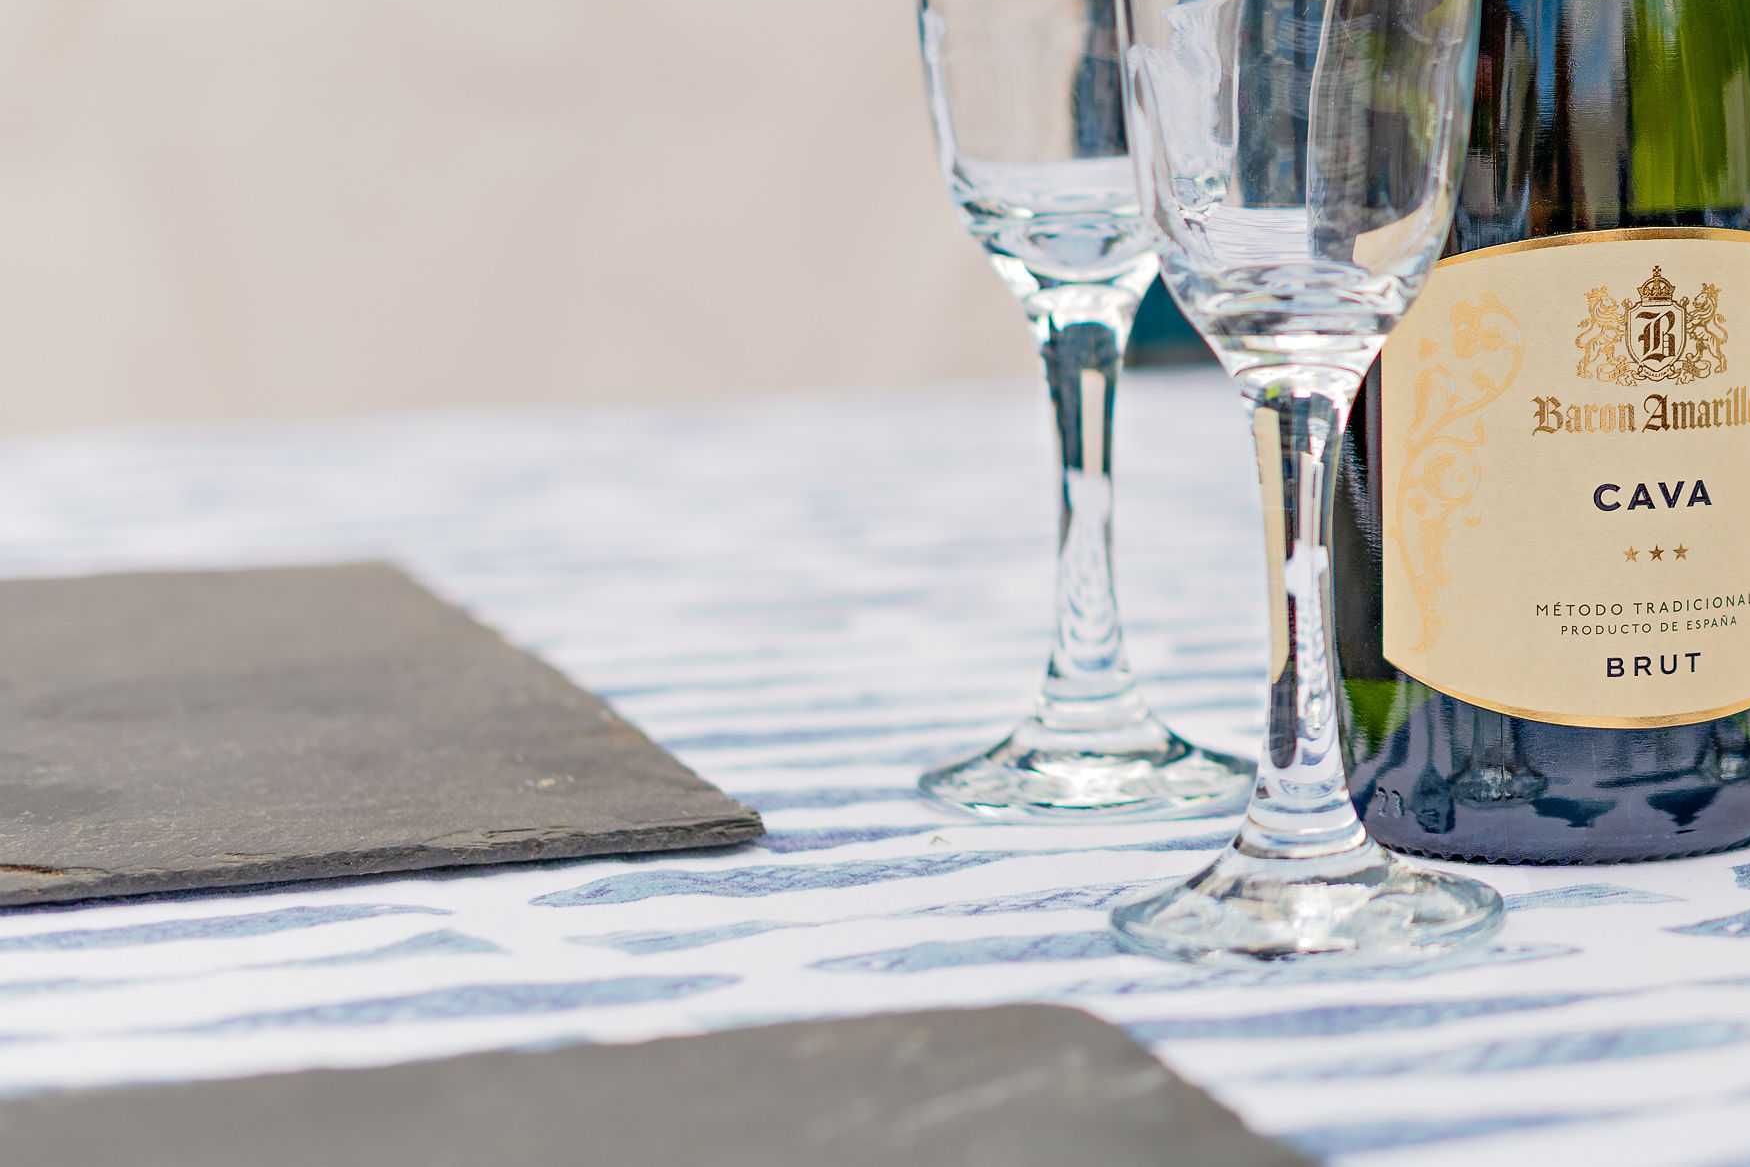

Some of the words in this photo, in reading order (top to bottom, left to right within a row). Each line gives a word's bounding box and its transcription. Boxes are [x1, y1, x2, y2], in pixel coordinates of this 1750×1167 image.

[1635, 310, 1676, 363] B
[1530, 395, 1637, 437] Baron
[1593, 479, 1713, 512] CAVA
[1536, 601, 1624, 617] MÉTODO
[1561, 623, 1652, 636] PRODUCTO
[1660, 621, 1678, 632] DE
[1686, 615, 1737, 631] ESPAÑA
[1606, 652, 1702, 678] BRUT
